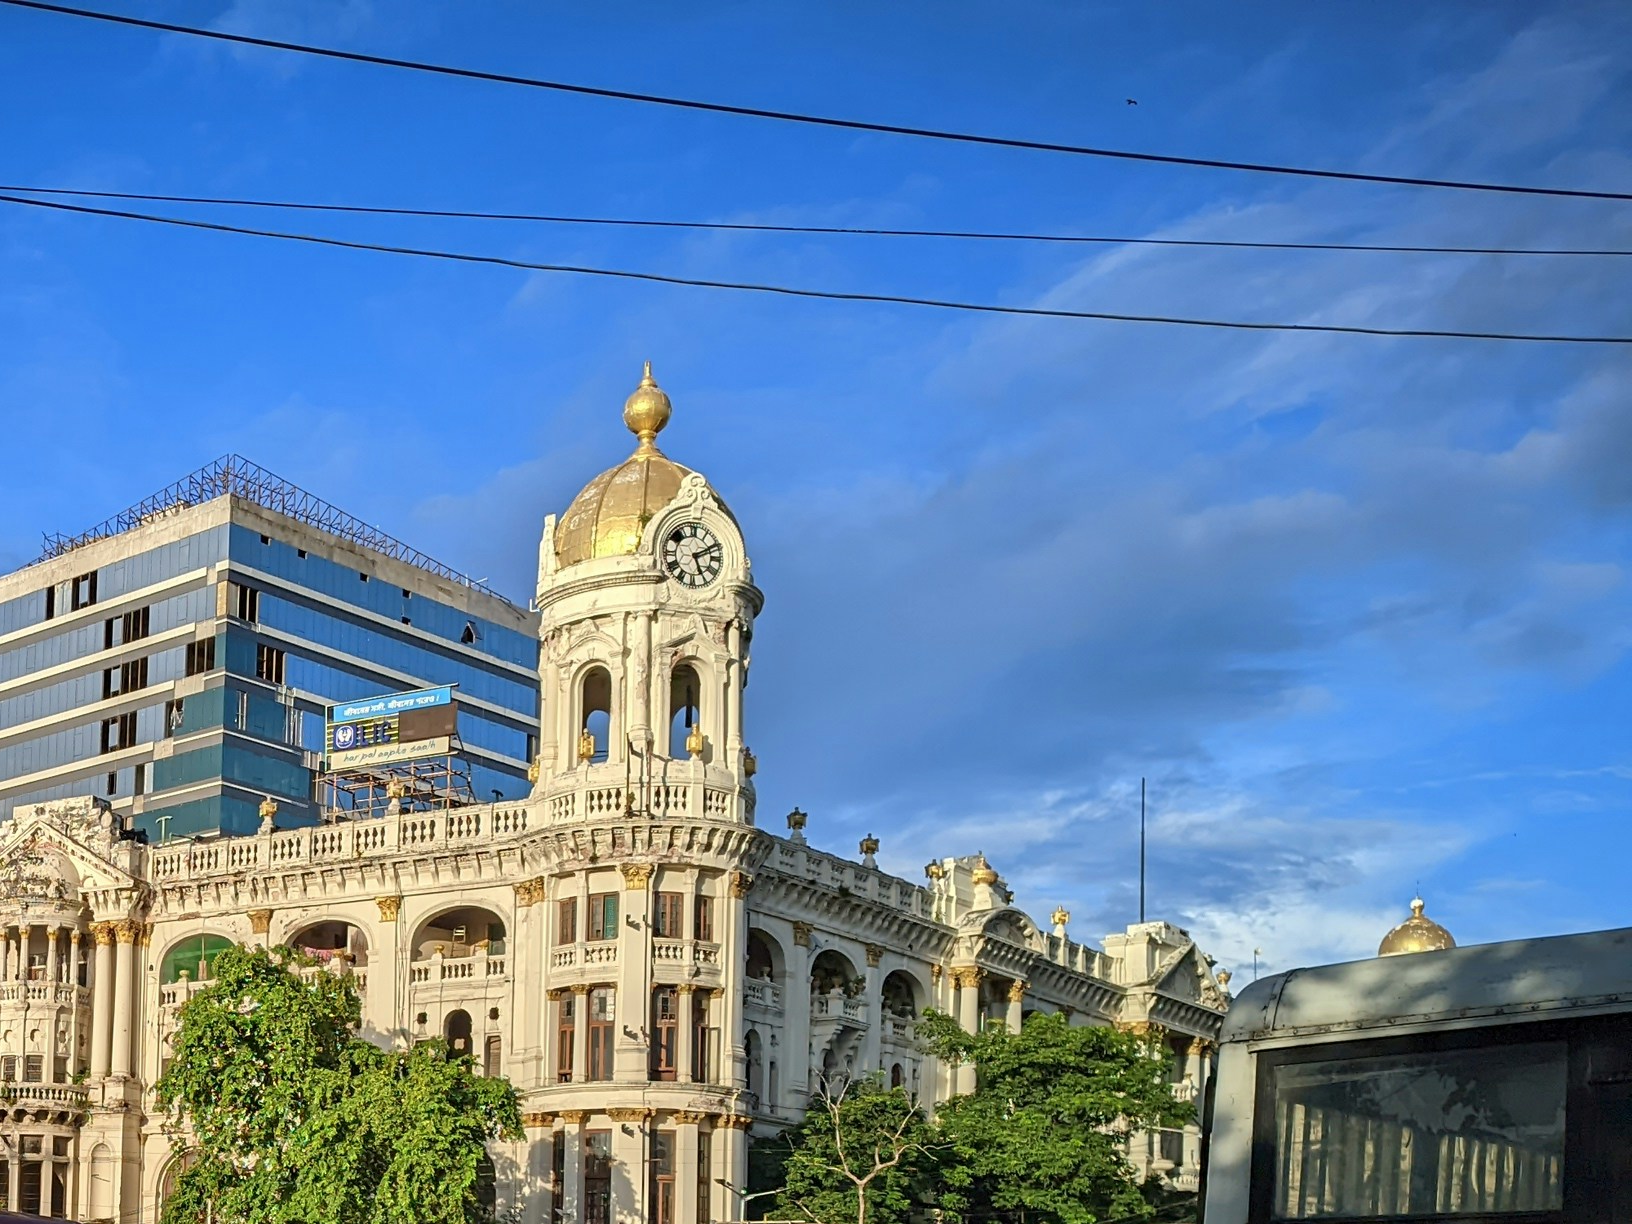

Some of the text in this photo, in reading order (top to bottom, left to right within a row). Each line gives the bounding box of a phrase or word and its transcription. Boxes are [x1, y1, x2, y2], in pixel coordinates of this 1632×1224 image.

[358, 720, 392, 747] LIC
[343, 753, 359, 762] har
[359, 748, 376, 763] pal
